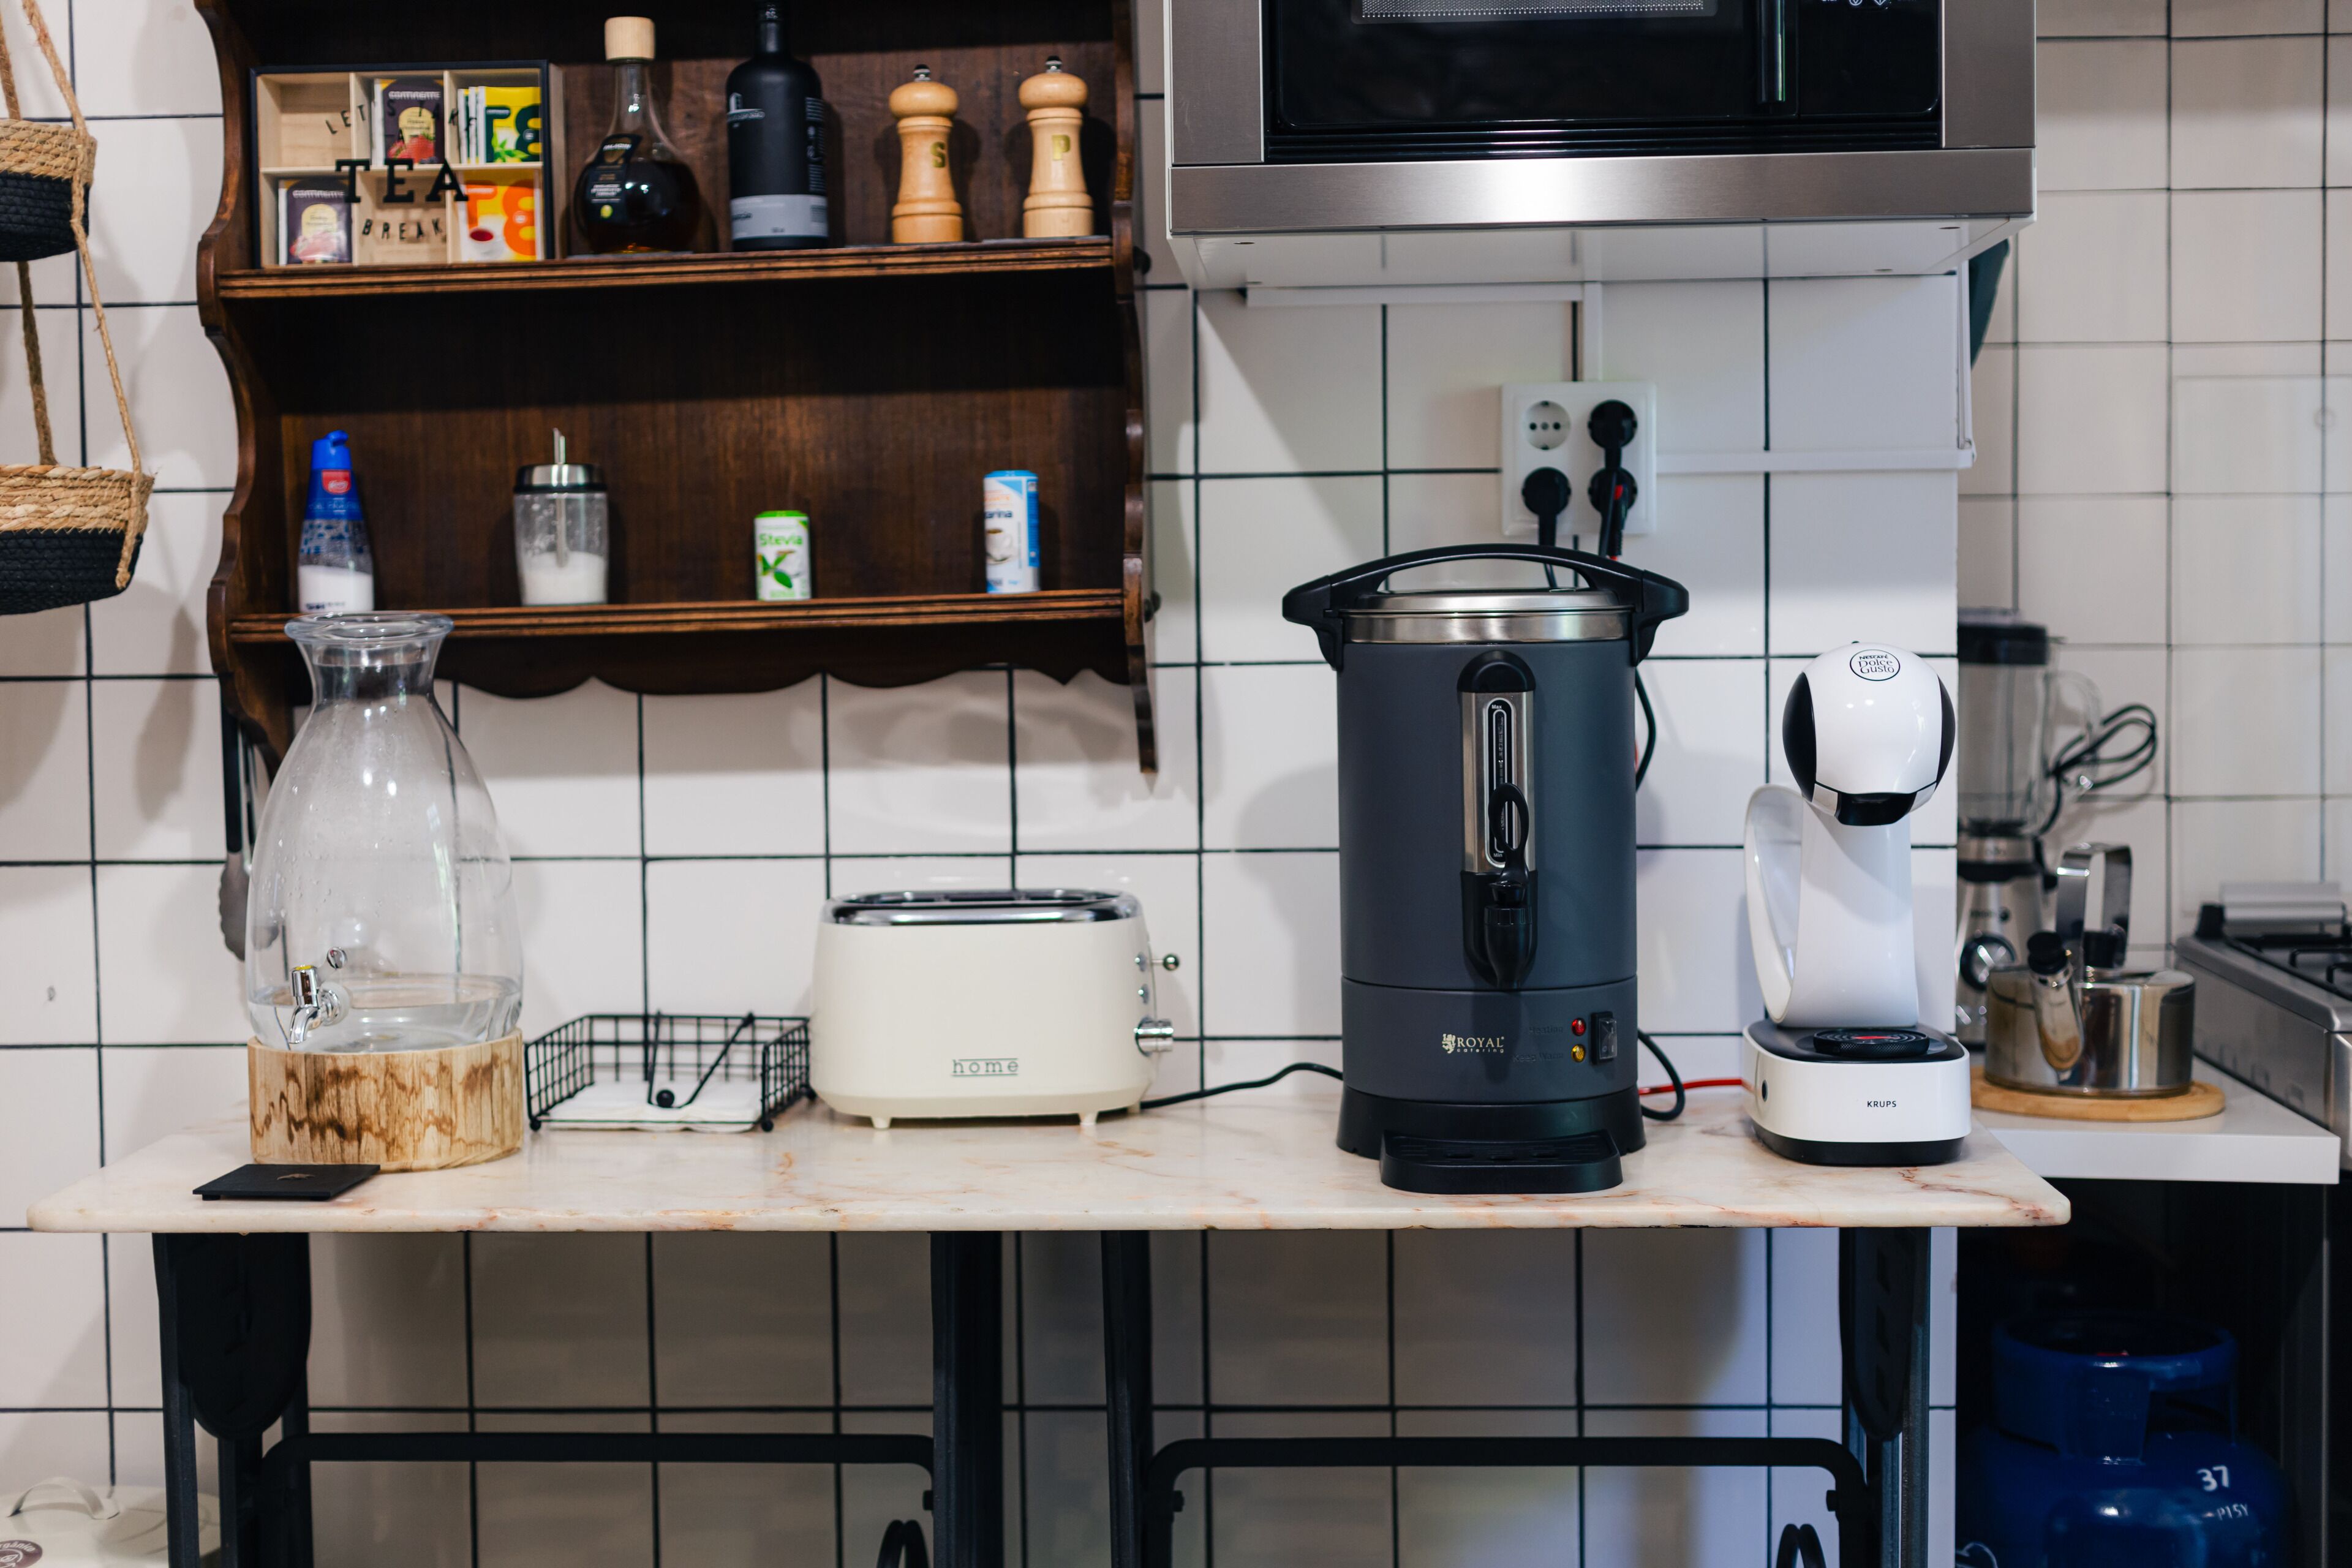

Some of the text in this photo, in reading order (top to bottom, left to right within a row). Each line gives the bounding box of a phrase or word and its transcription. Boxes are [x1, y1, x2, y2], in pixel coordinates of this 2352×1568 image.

[930, 141, 946, 168] S
[1051, 134, 1071, 161] P
[335, 158, 469, 203] TEA
[362, 217, 442, 240] BREAK
[759, 533, 803, 546] Stevia
[1457, 1037, 1504, 1047] ROYAL
[952, 1059, 1019, 1074] home
[2196, 1464, 2230, 1492] 37
